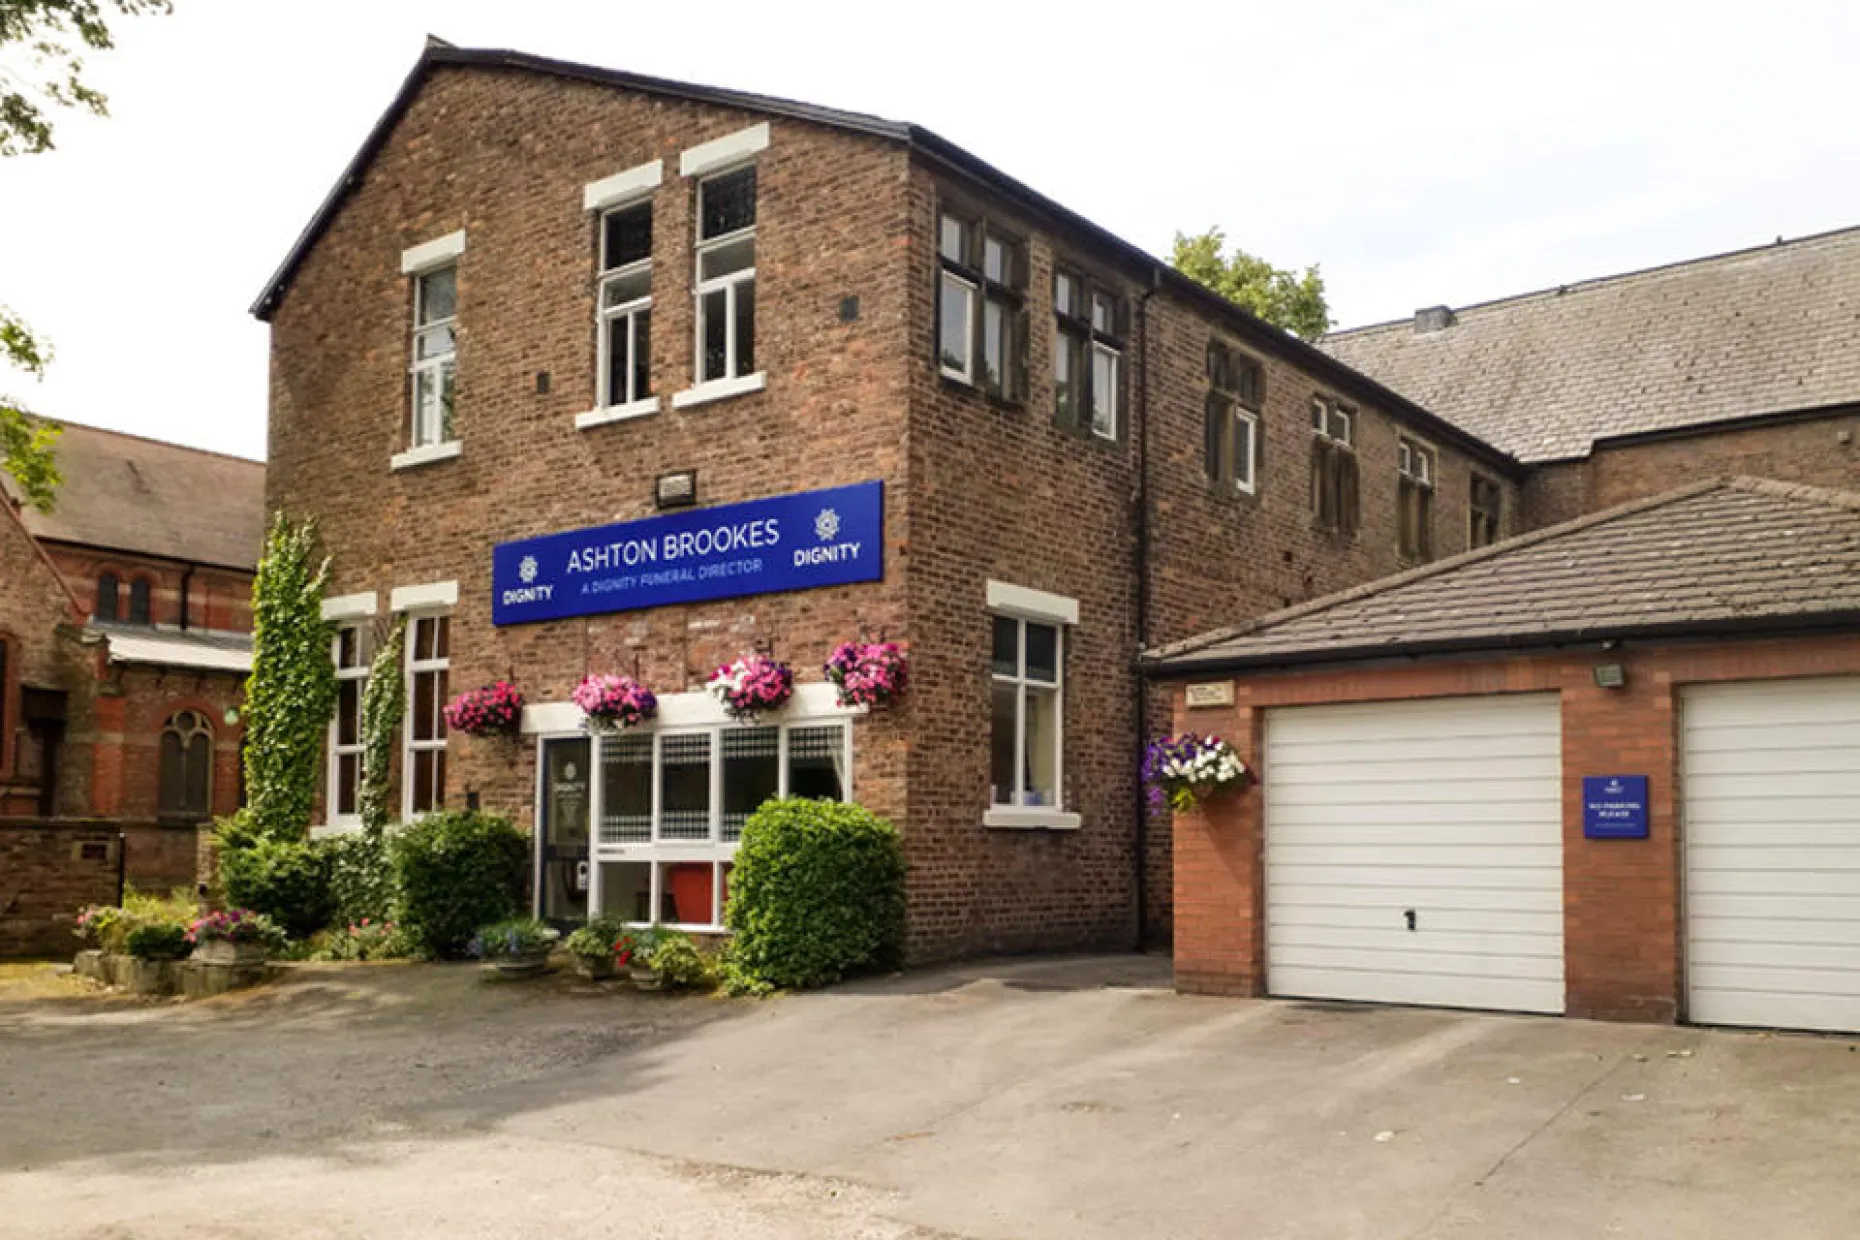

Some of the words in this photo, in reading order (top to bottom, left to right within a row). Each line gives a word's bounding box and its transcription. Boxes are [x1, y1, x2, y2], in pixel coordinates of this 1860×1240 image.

[566, 536, 658, 574] ASHTON
[663, 518, 780, 560] BROOKES
[793, 542, 861, 567] DIGNITY
[580, 582, 590, 595] A
[592, 575, 637, 594] DIGNITY
[640, 567, 696, 588] FUNERAL
[698, 557, 763, 579] DIRECTOR
[502, 584, 554, 606] DIGNITY
